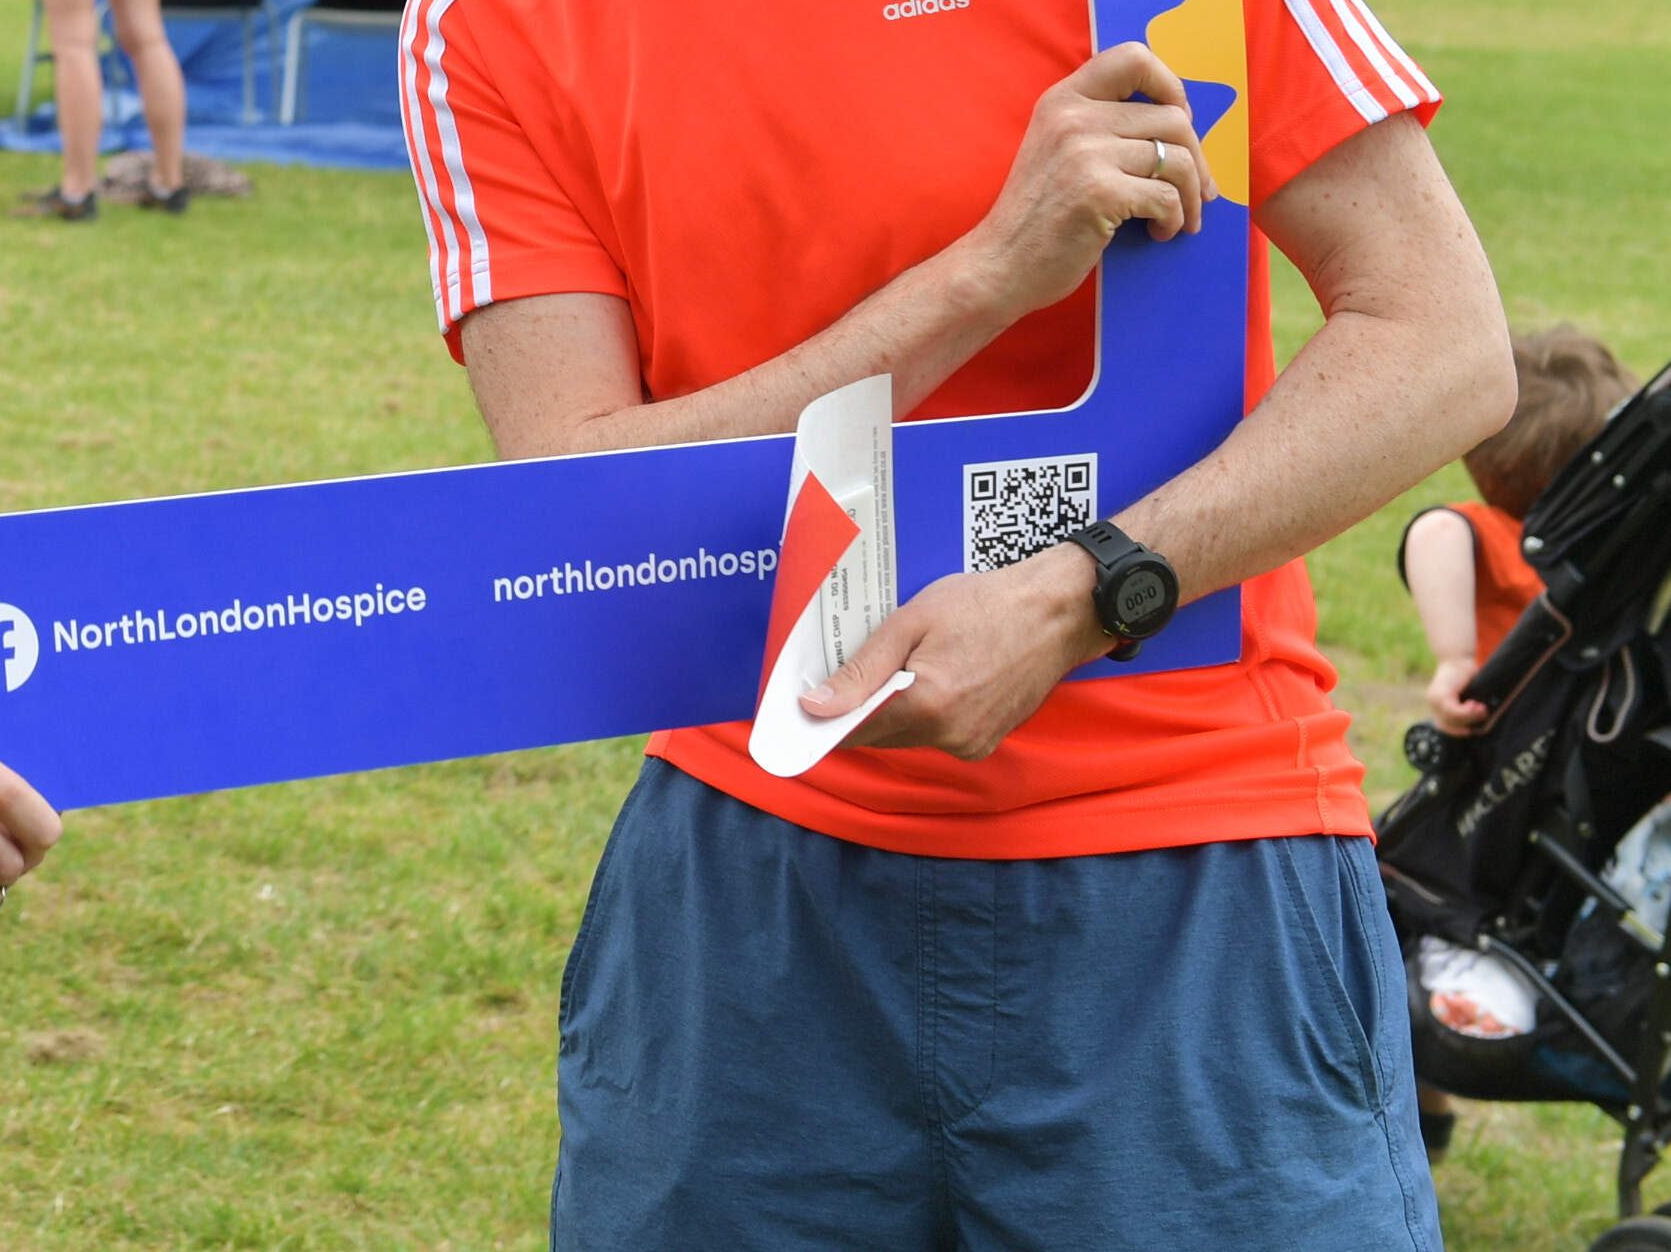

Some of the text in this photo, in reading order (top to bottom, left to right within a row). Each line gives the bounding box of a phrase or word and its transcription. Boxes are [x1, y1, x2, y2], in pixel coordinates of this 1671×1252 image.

[493, 540, 783, 603] northlondonhosp
[831, 581, 839, 597] DO
[53, 582, 427, 654] NorthLondonHospice
[831, 614, 841, 638] CHIP
[833, 640, 845, 668] MING
